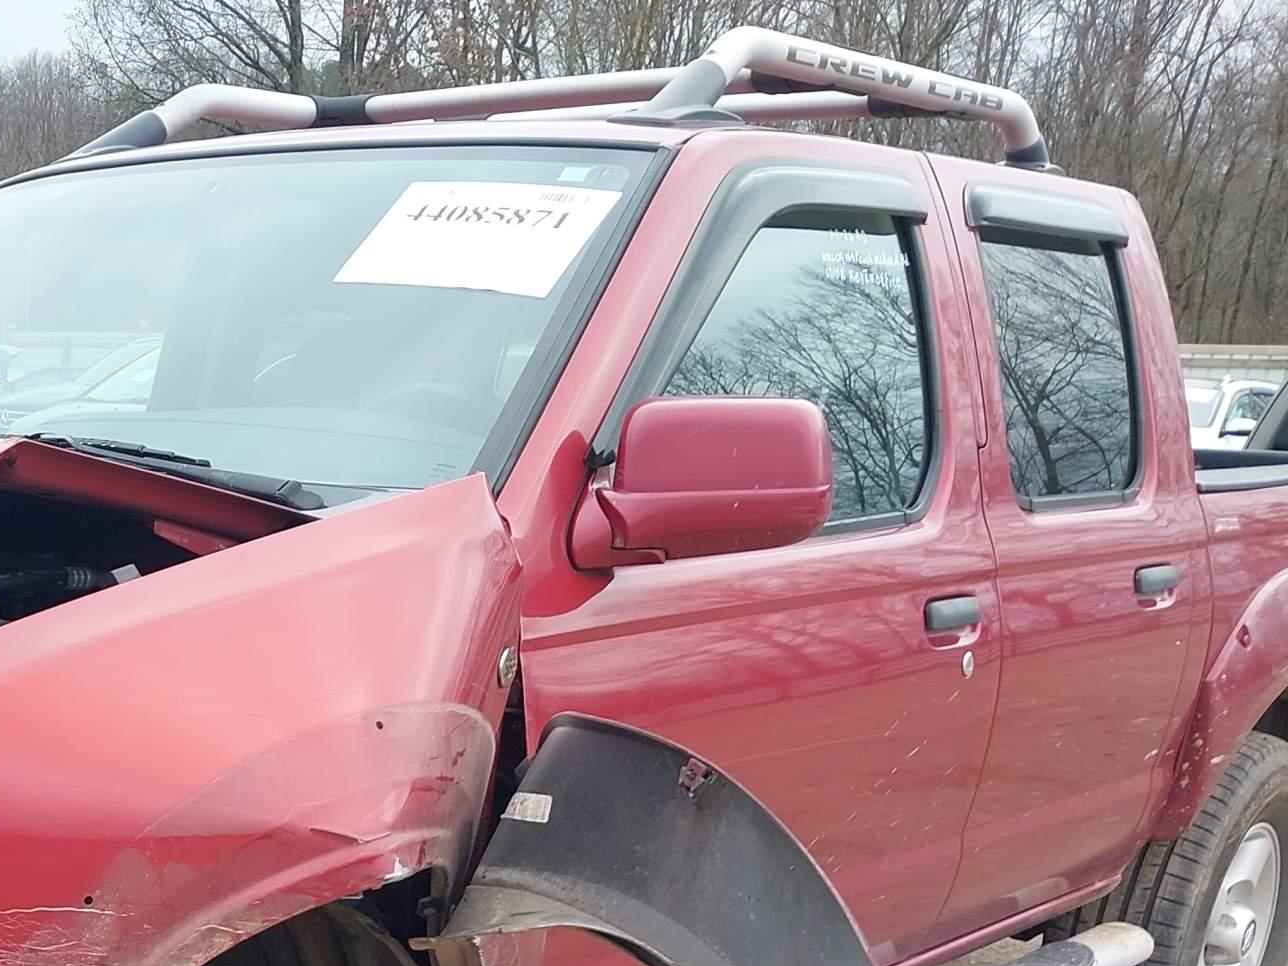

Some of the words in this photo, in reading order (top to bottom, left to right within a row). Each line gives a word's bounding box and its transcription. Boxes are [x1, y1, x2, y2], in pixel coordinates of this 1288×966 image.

[786, 45, 913, 89] CREW
[928, 80, 1005, 111] CAB
[406, 203, 570, 229] 44085871
